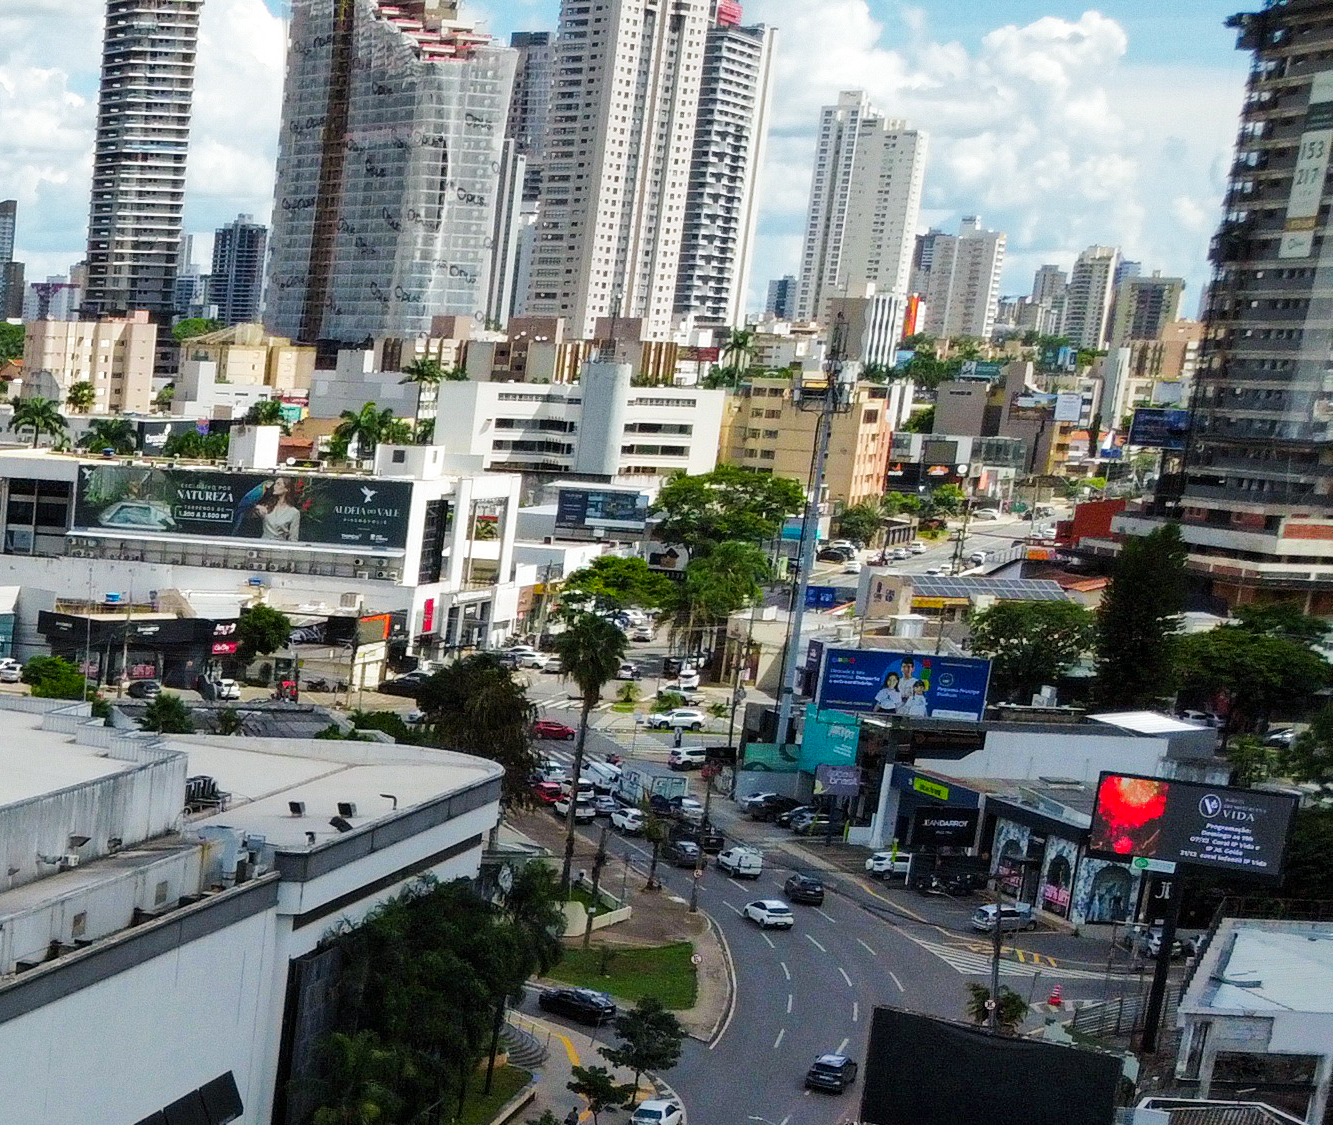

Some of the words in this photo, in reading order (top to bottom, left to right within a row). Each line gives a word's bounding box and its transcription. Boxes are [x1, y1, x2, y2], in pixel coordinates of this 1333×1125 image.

[1300, 140, 1324, 160] 153
[1295, 167, 1319, 185] 217
[457, 187, 487, 207] Opus
[177, 489, 234, 503] NATUREZA
[333, 505, 366, 516] ALDEIA
[377, 508, 401, 518] VALE
[1223, 810, 1255, 822] VIDA
[1201, 830, 1231, 839] Domingo
